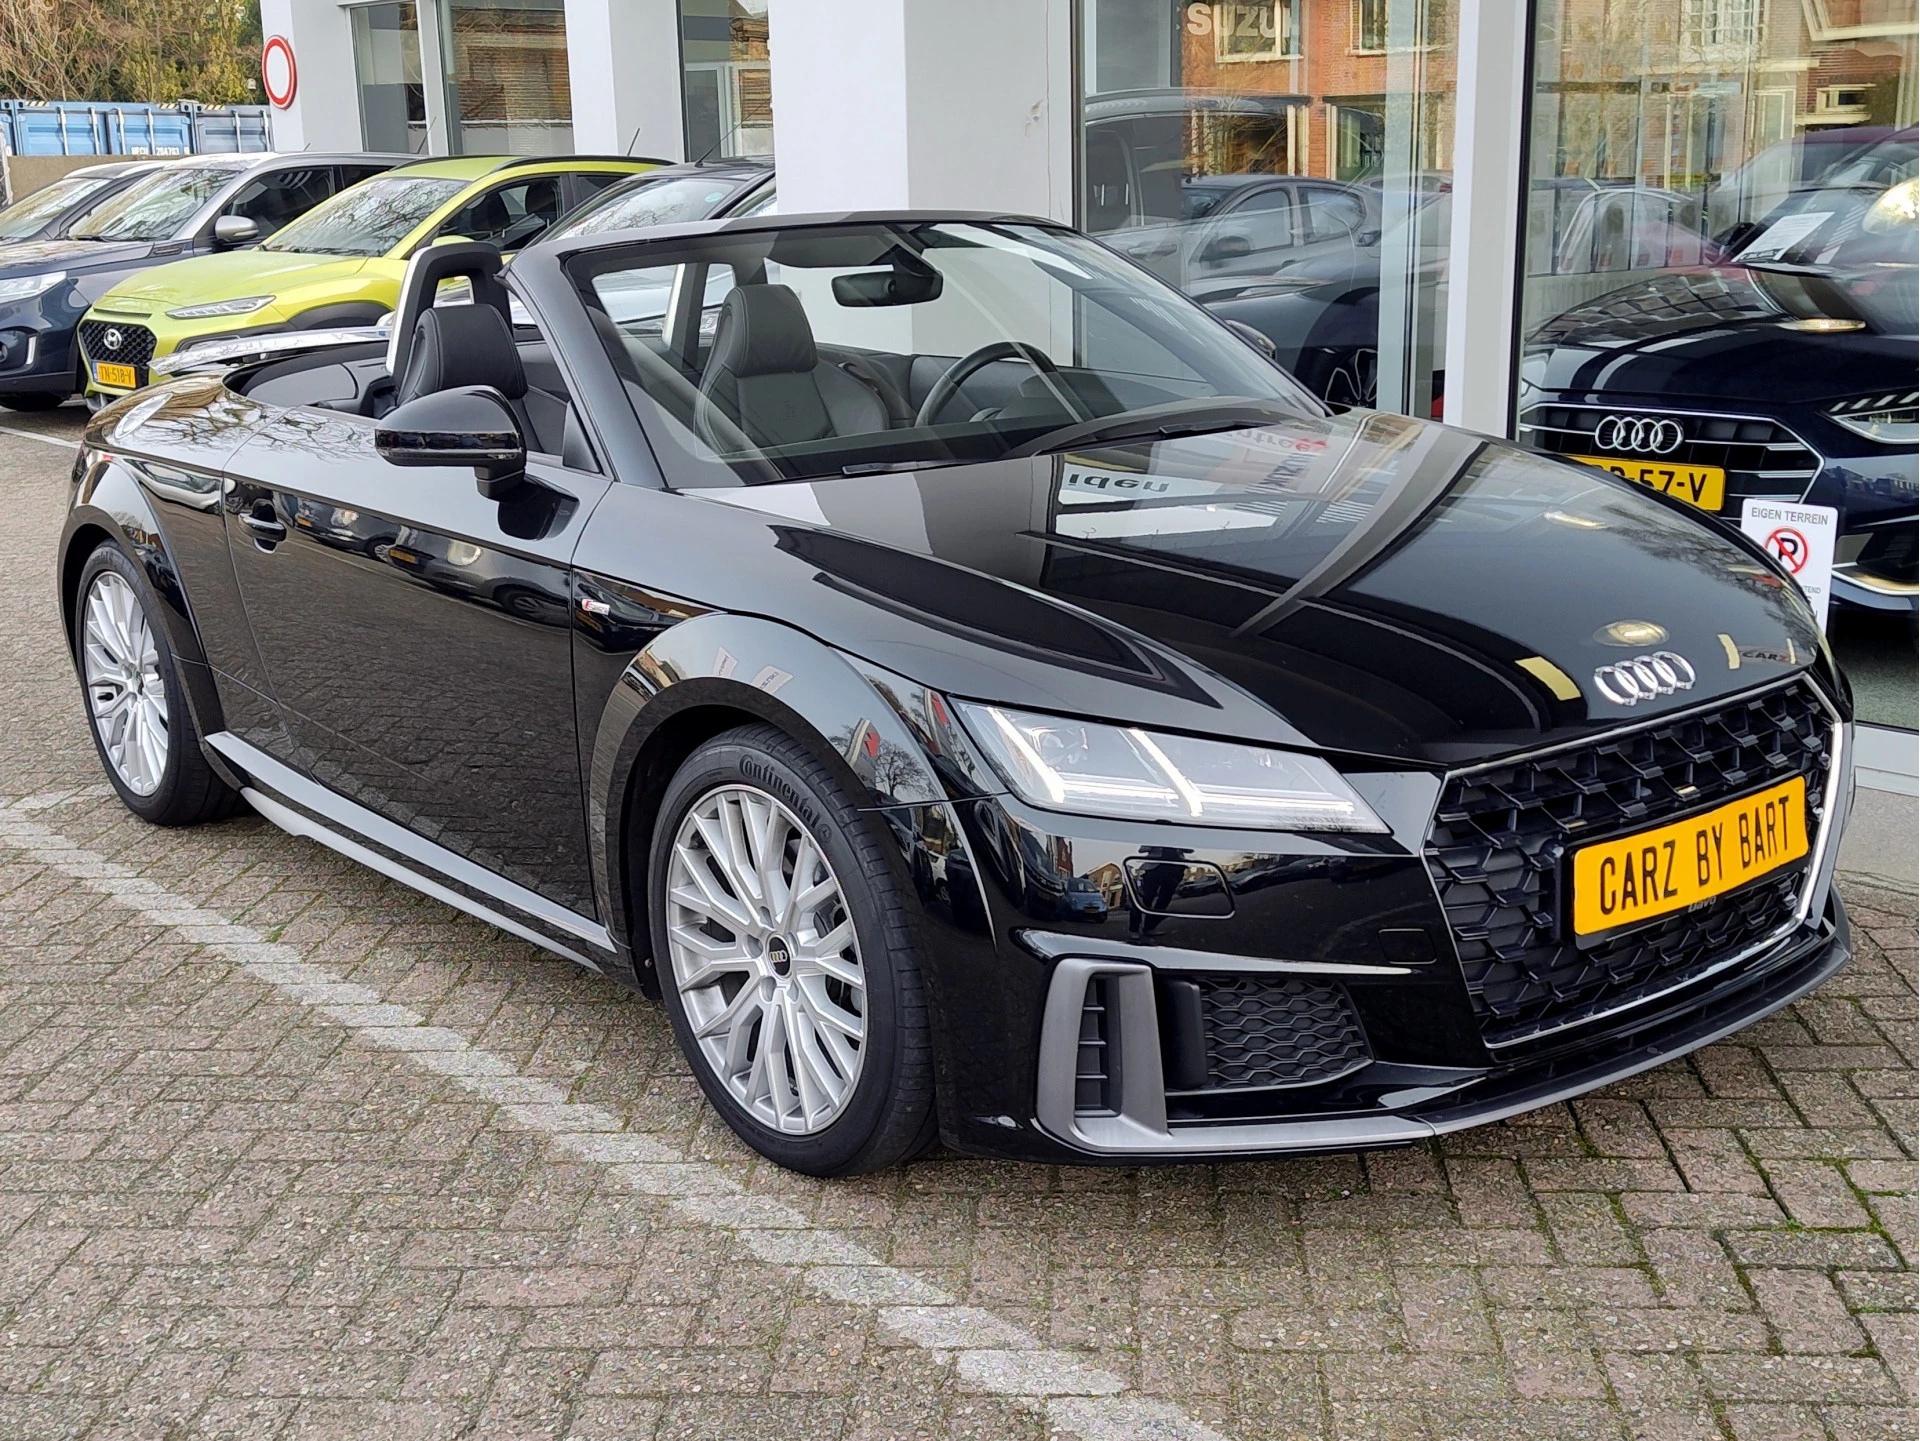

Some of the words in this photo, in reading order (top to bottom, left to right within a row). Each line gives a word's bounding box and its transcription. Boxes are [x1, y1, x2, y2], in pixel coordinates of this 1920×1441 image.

[1751, 507, 1781, 520] EIGEN
[1784, 510, 1828, 525] TERREIN
[739, 753, 821, 829] Continental
[1600, 840, 1678, 916] CARZ
[1696, 822, 1723, 888] BY
[1739, 796, 1789, 869] BART
